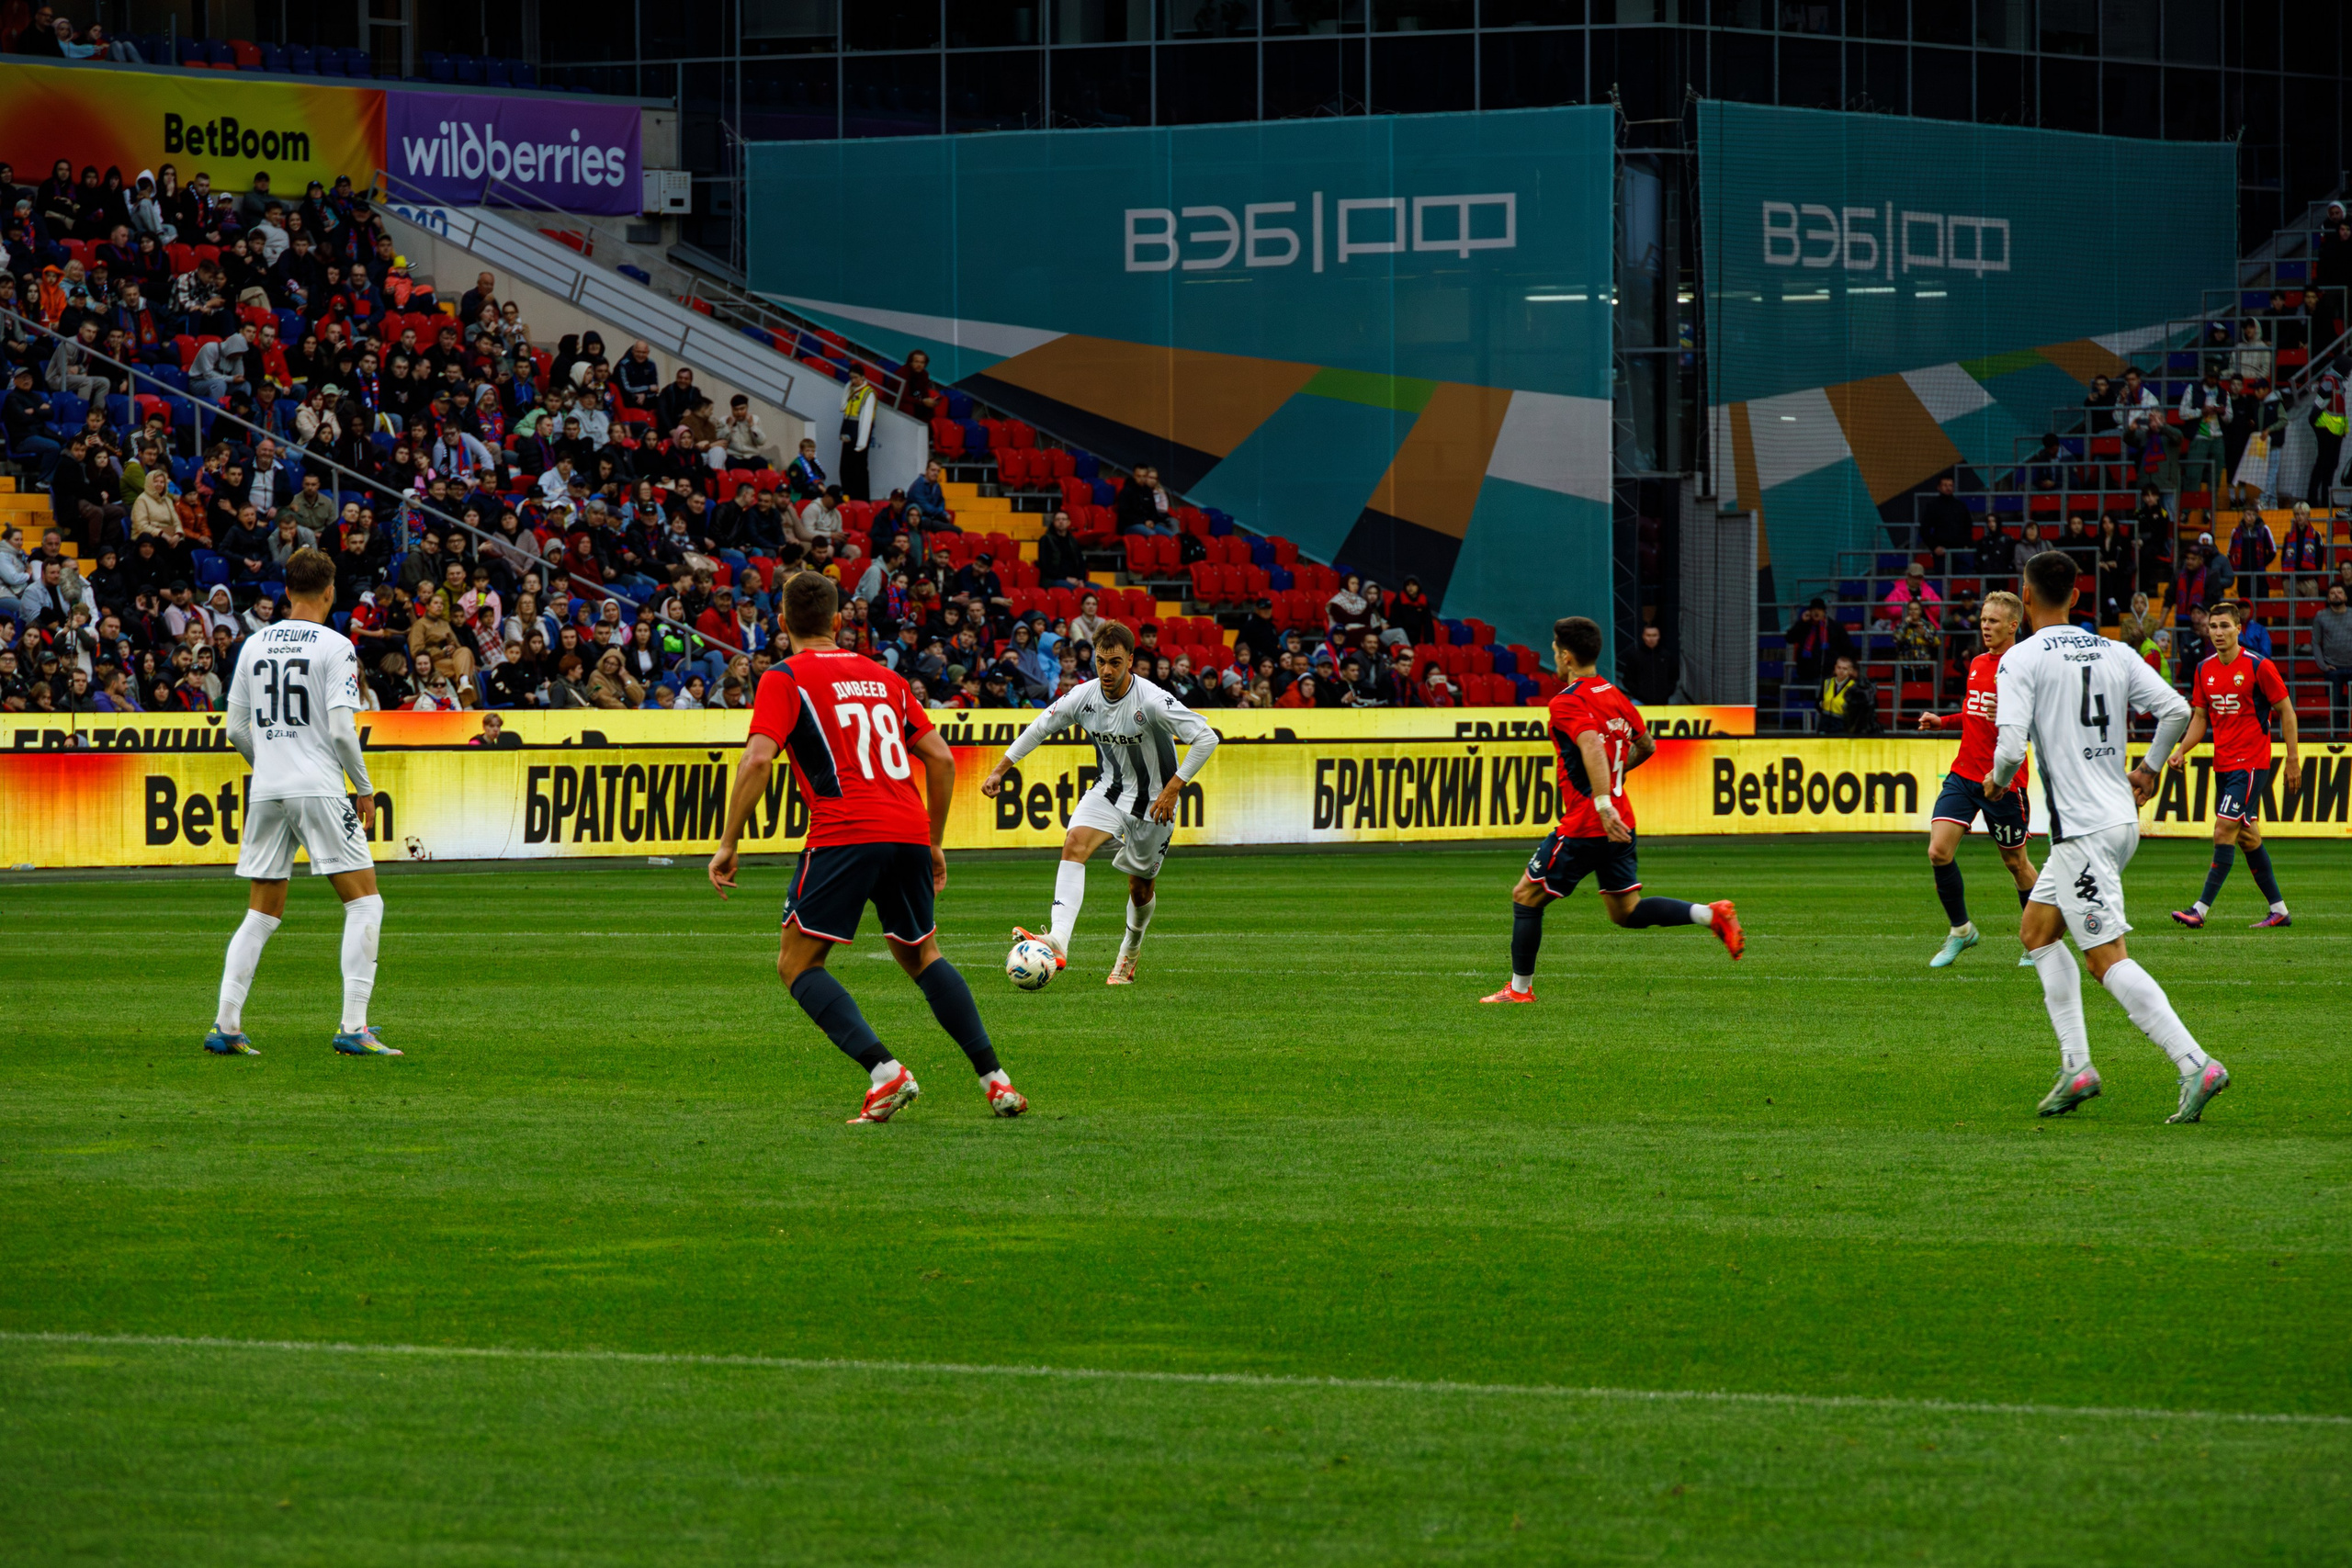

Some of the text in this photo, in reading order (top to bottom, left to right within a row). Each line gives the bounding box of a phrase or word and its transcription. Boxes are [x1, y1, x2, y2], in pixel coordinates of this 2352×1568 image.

[164, 113, 310, 162] BetBoom
[402, 120, 626, 186] wildberries
[253, 658, 311, 728] 36
[831, 681, 888, 701] ДИВЕЕВ
[2080, 665, 2109, 742] 4
[834, 702, 910, 781] 78
[1091, 731, 1143, 745] MAXBET
[525, 751, 728, 843] БРАТСКИЙ
[1313, 745, 1483, 829] БРАТСКИЙ
[1489, 755, 1566, 826] КУБ
[1713, 756, 1918, 816] BetBoom
[1994, 823, 2011, 844] 31
